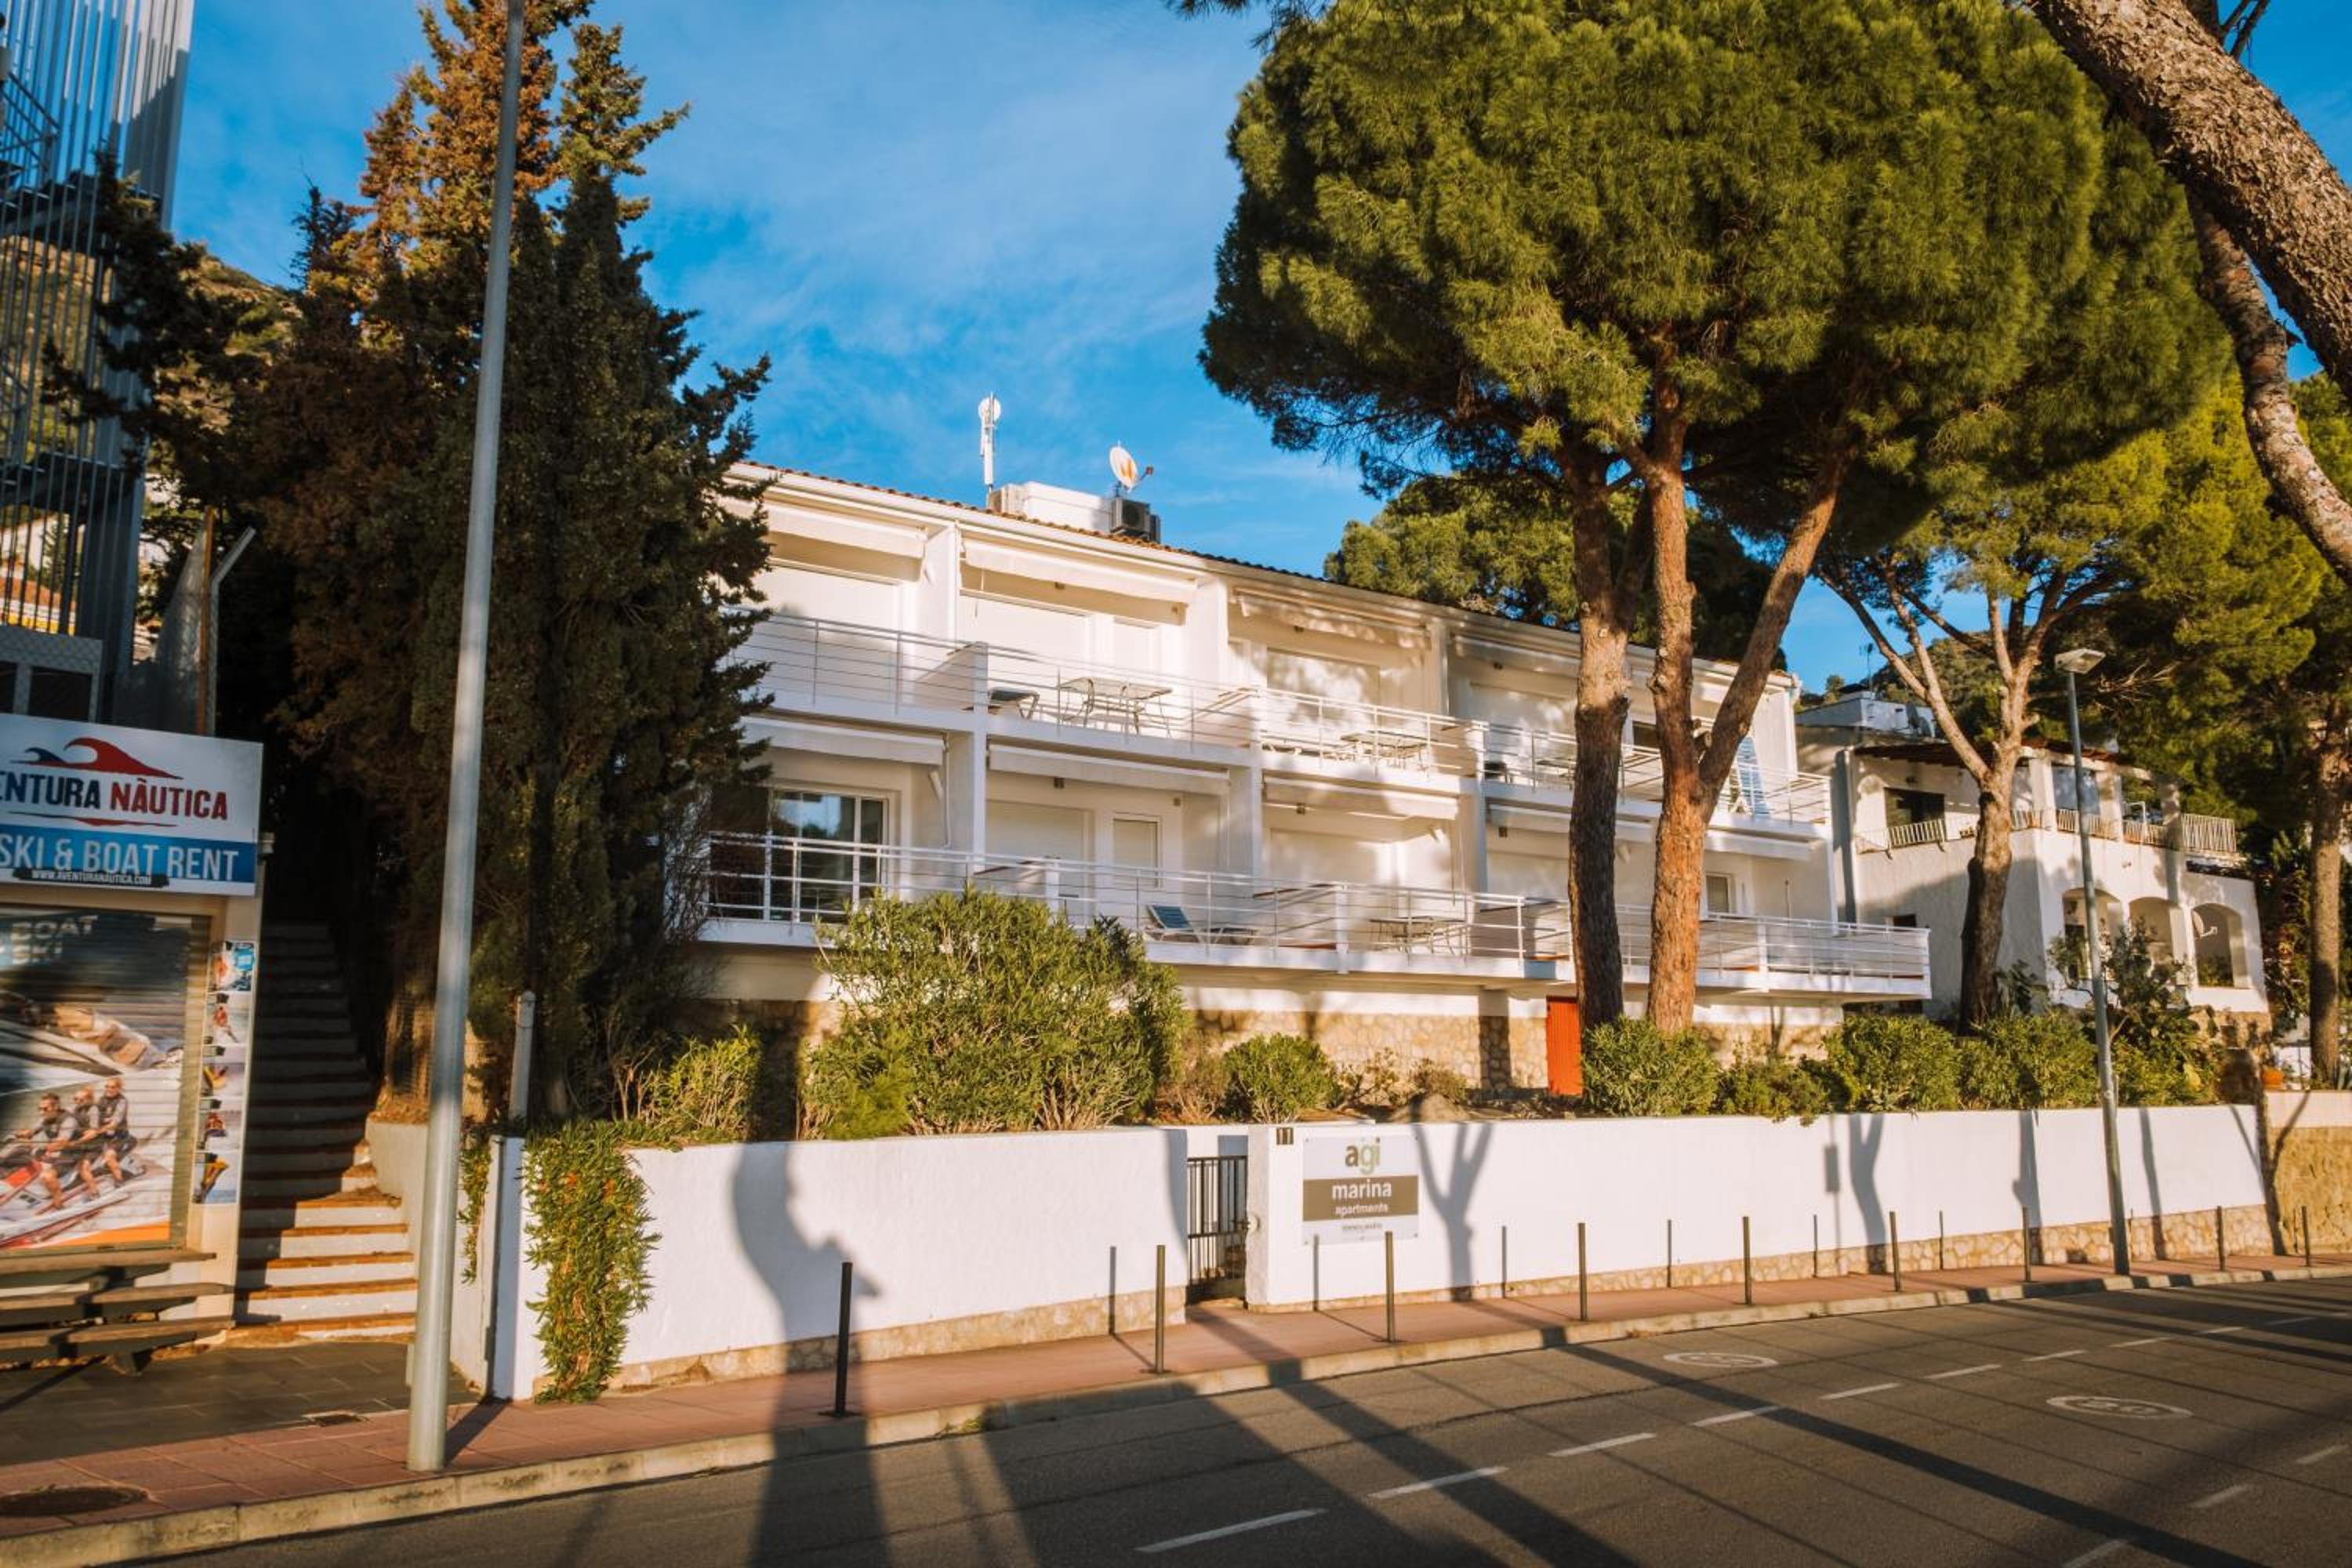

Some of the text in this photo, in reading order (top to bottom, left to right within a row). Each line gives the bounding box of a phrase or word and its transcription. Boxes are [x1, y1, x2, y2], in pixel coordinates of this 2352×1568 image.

[54, 838, 74, 870] &
[83, 840, 159, 876] BOAT
[167, 846, 239, 881] RENT
[1345, 1137, 1380, 1174] agi
[1332, 1179, 1392, 1200] marina
[1335, 1203, 1388, 1218] apartments
